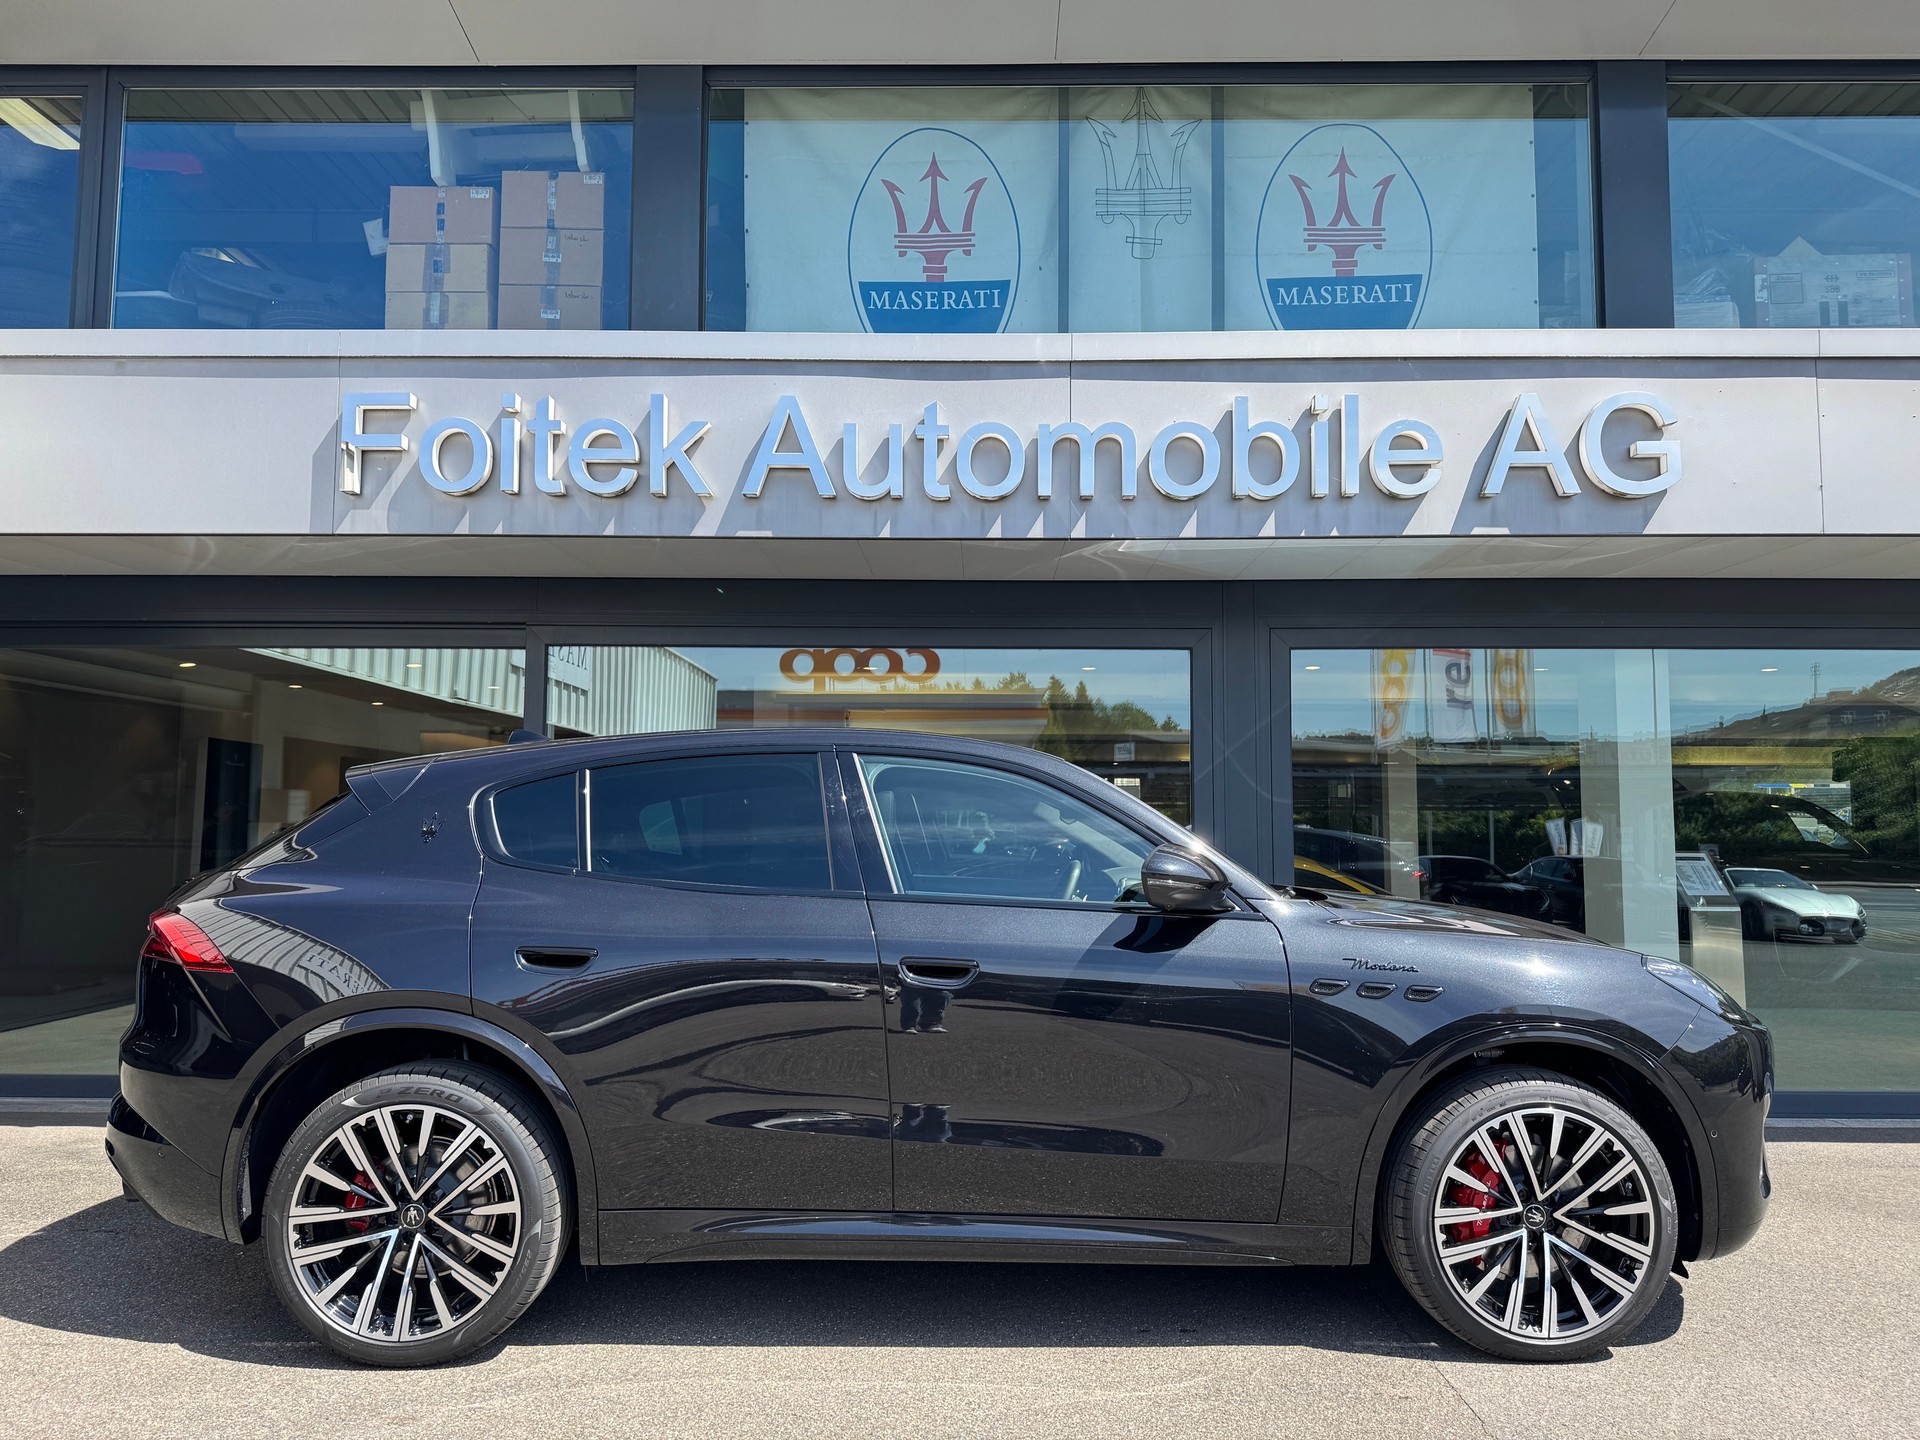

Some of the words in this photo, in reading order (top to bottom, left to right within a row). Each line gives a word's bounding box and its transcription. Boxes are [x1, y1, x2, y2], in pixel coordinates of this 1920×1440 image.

[867, 289, 1001, 310] MASERATI
[1276, 283, 1413, 306] MASERATI
[341, 392, 714, 498] Foitek
[741, 393, 1444, 501] Automobile
[1479, 391, 1682, 499] AG
[1342, 957, 1419, 973] Modena
[396, 1086, 463, 1103] ZERO
